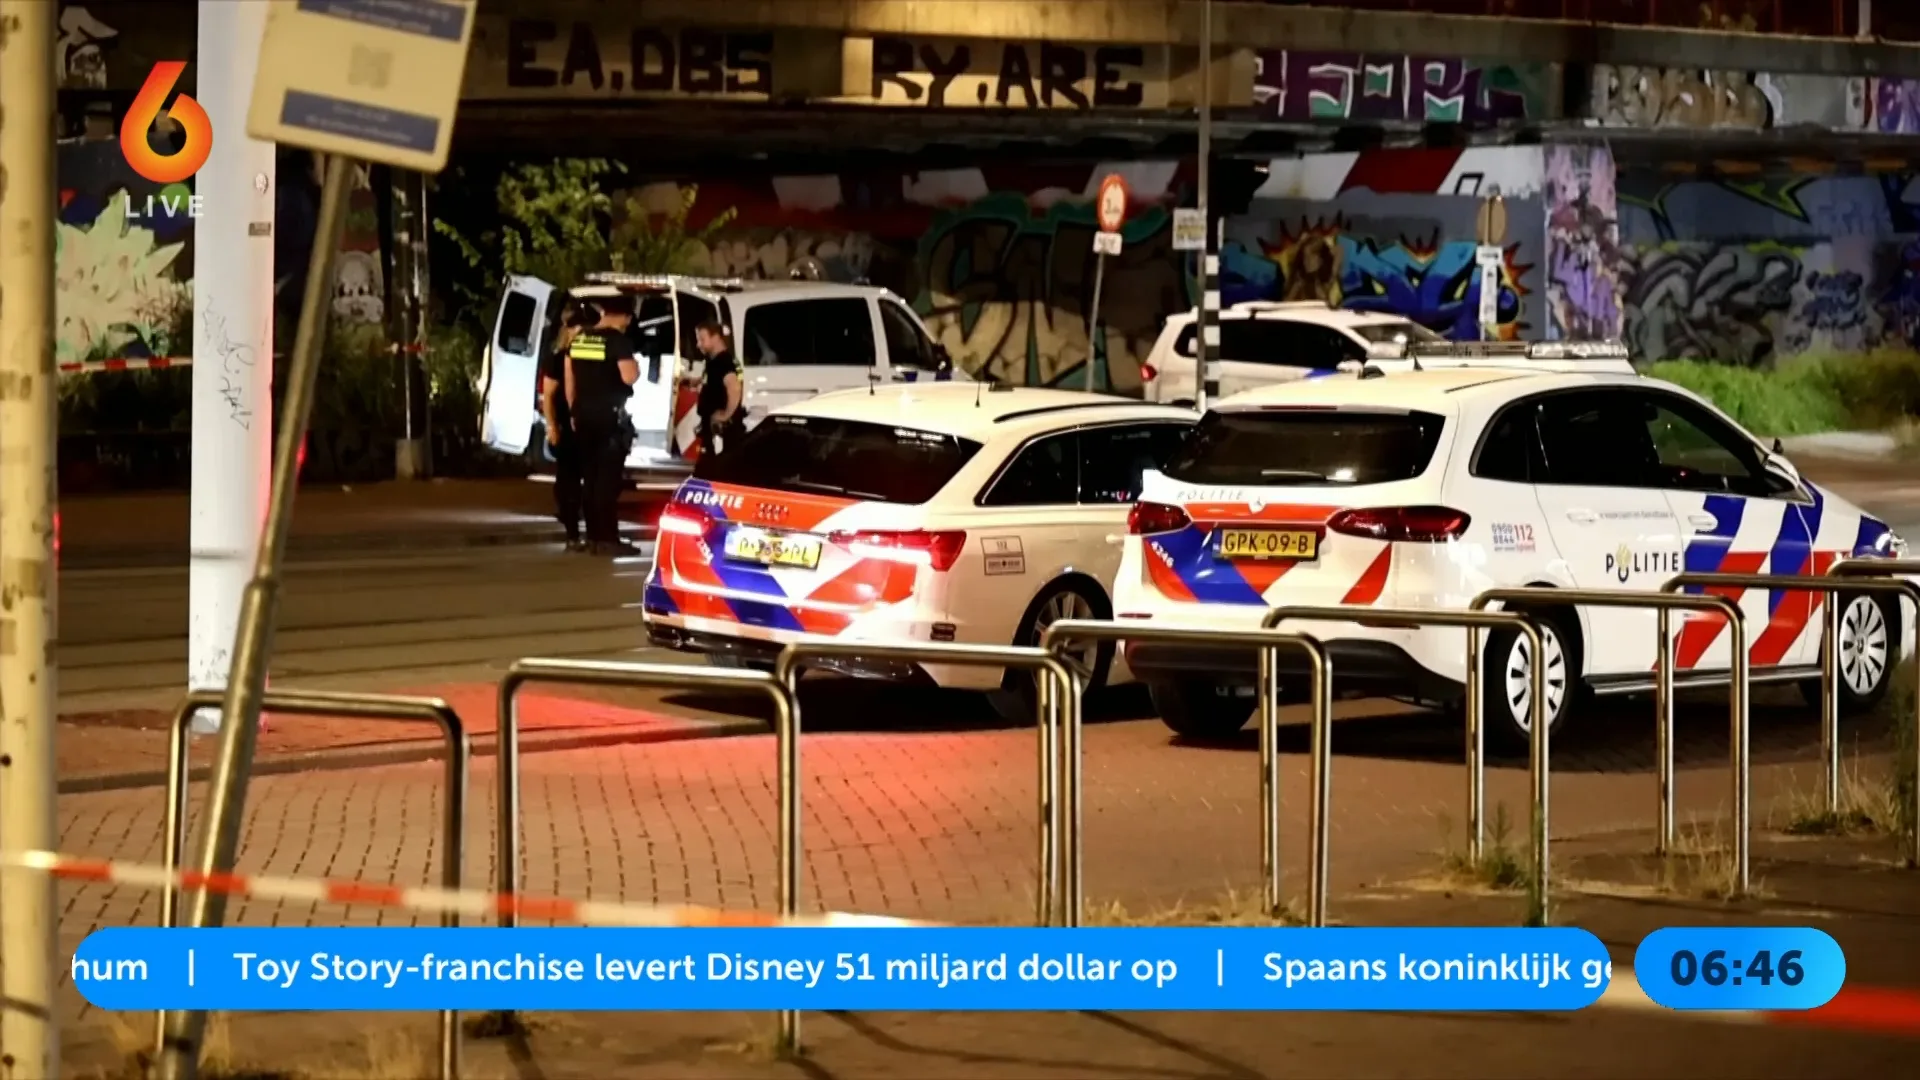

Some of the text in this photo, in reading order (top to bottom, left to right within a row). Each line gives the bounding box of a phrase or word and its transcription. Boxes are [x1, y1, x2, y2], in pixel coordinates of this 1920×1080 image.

[1176, 489, 1243, 501] POLITIE
[1514, 524, 1535, 541] 112
[1224, 532, 1310, 554] GPK-09-B
[1605, 548, 1679, 583] POLITIE
